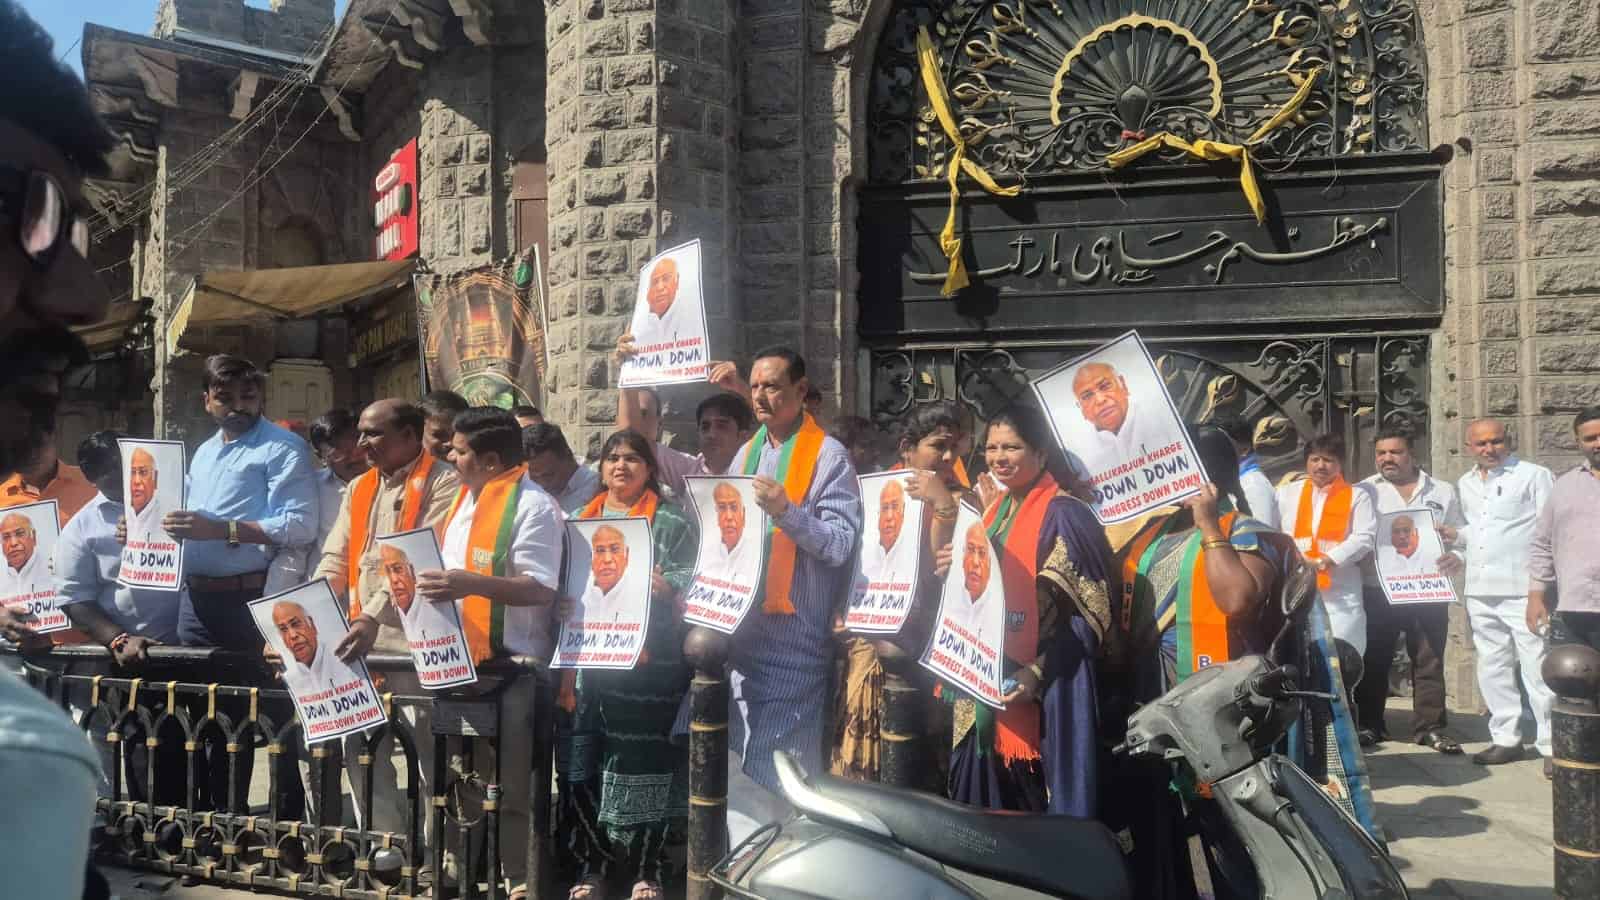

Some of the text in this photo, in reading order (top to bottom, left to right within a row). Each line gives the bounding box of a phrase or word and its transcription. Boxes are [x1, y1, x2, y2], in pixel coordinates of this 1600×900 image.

[670, 348, 703, 366] DOWN
[684, 366, 705, 376] DOWN
[1147, 441, 1184, 463] KHARGE
[1092, 453, 1190, 505] DOWN DOWN
[1099, 471, 1201, 518] CONGRESS DOWN DOWN
[140, 551, 175, 568] DOWN
[133, 570, 155, 582] DOWN
[155, 572, 177, 584] DOWN
[1390, 579, 1446, 592] DOWN DOWN
[689, 585, 744, 612] DOWN DOWN
[880, 592, 905, 610] DOWN
[44, 614, 66, 626] DOWN
[425, 634, 457, 649] KHARGE
[566, 632, 635, 649] DOWN DOWN
[421, 647, 460, 667] DOWN
[939, 628, 995, 681] DOWN DOWN
[444, 665, 469, 680] DOWN
[930, 649, 1000, 698] CONGRESS DOWN DOWN
[334, 679, 365, 695] KHARGE
[331, 689, 370, 714] DOWN
[334, 711, 357, 729] DOWN
[355, 706, 380, 723] DOWN
